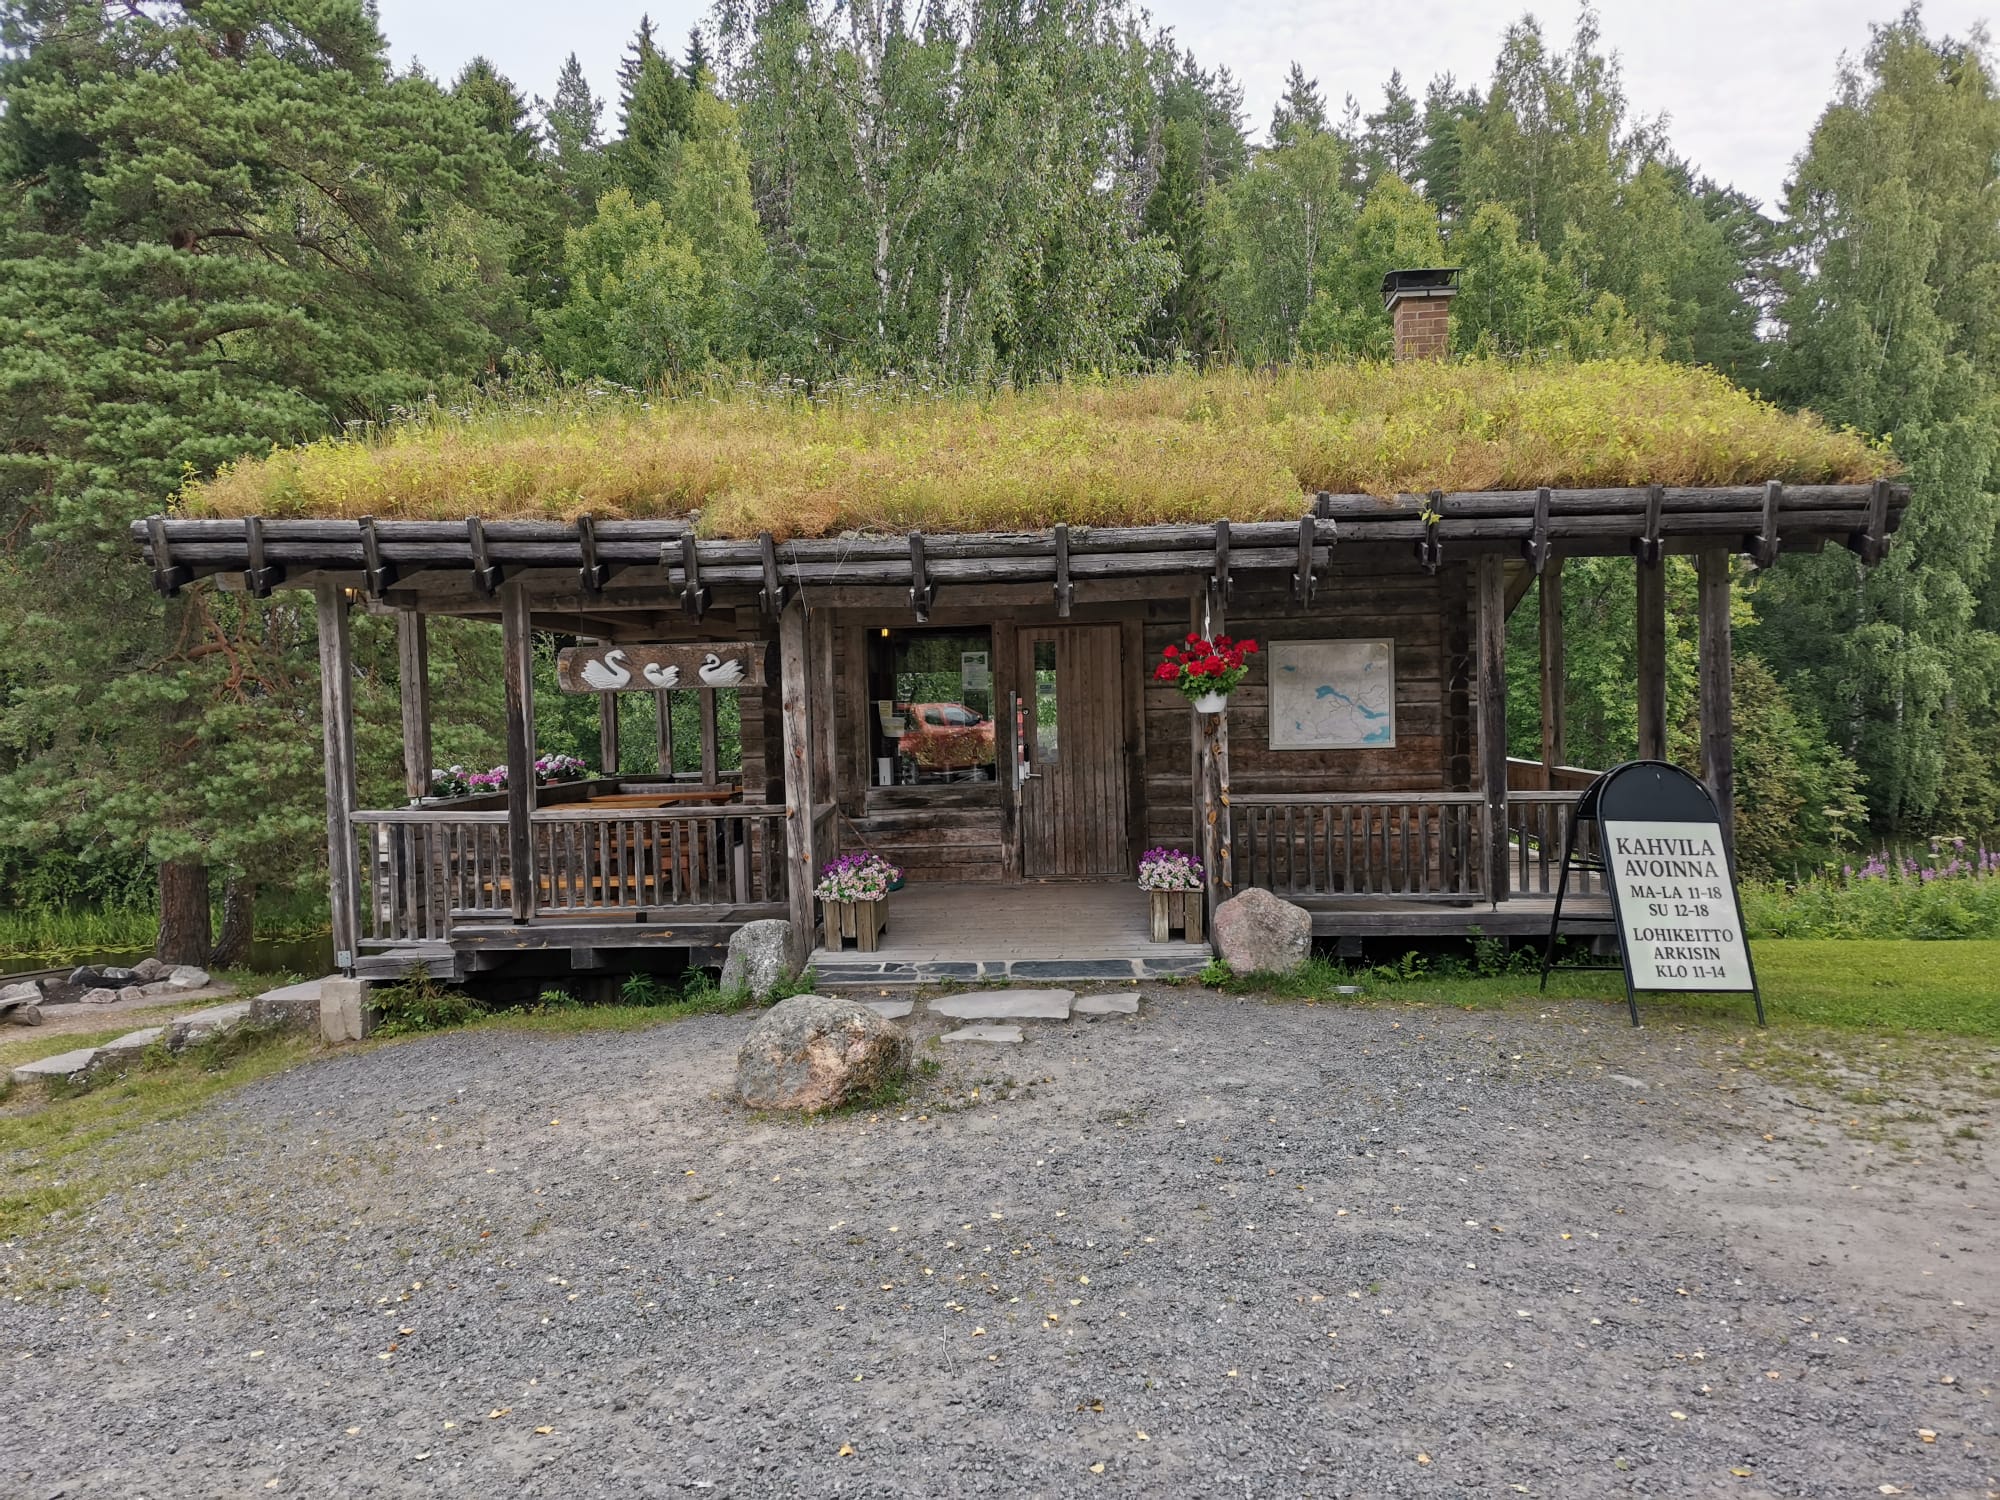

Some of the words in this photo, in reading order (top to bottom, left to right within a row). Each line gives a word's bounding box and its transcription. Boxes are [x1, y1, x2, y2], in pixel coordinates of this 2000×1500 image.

[1616, 837, 1715, 856] KAHVILA
[1625, 859, 1719, 878] AVOINNA
[1630, 884, 1683, 899] MA-LA
[1688, 886, 1722, 899] 11-18
[1648, 904, 1669, 917] SU
[1674, 904, 1709, 917] 12-18
[1633, 927, 1733, 943] LOHIKEITTO
[1654, 946, 1720, 960] ARKISIN
[1656, 964, 1688, 978] KLO
[1692, 965, 1726, 978] 11-14
